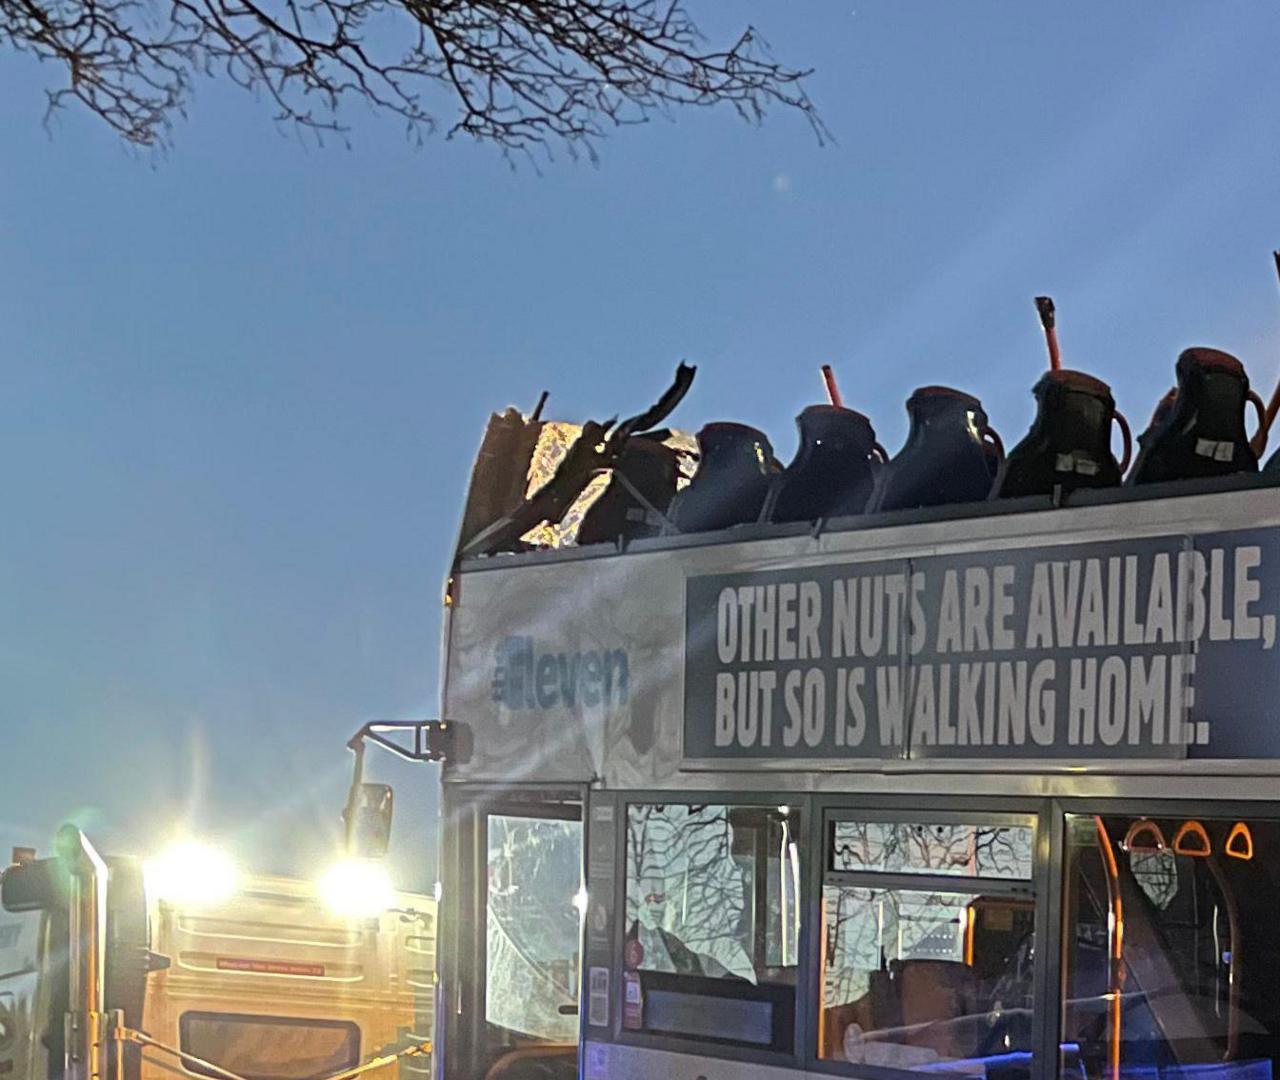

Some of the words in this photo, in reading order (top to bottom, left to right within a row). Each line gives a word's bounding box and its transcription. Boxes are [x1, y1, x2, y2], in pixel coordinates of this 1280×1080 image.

[717, 580, 822, 664] OTHER
[832, 571, 926, 658] NUTS
[937, 565, 1016, 654] ARE
[1026, 546, 1276, 649] AVAILABLE,
[715, 670, 777, 747] BUT
[783, 667, 826, 748] SO
[835, 666, 866, 747] IS
[876, 659, 1057, 747] WALKING
[1068, 653, 1210, 746] HOME.
